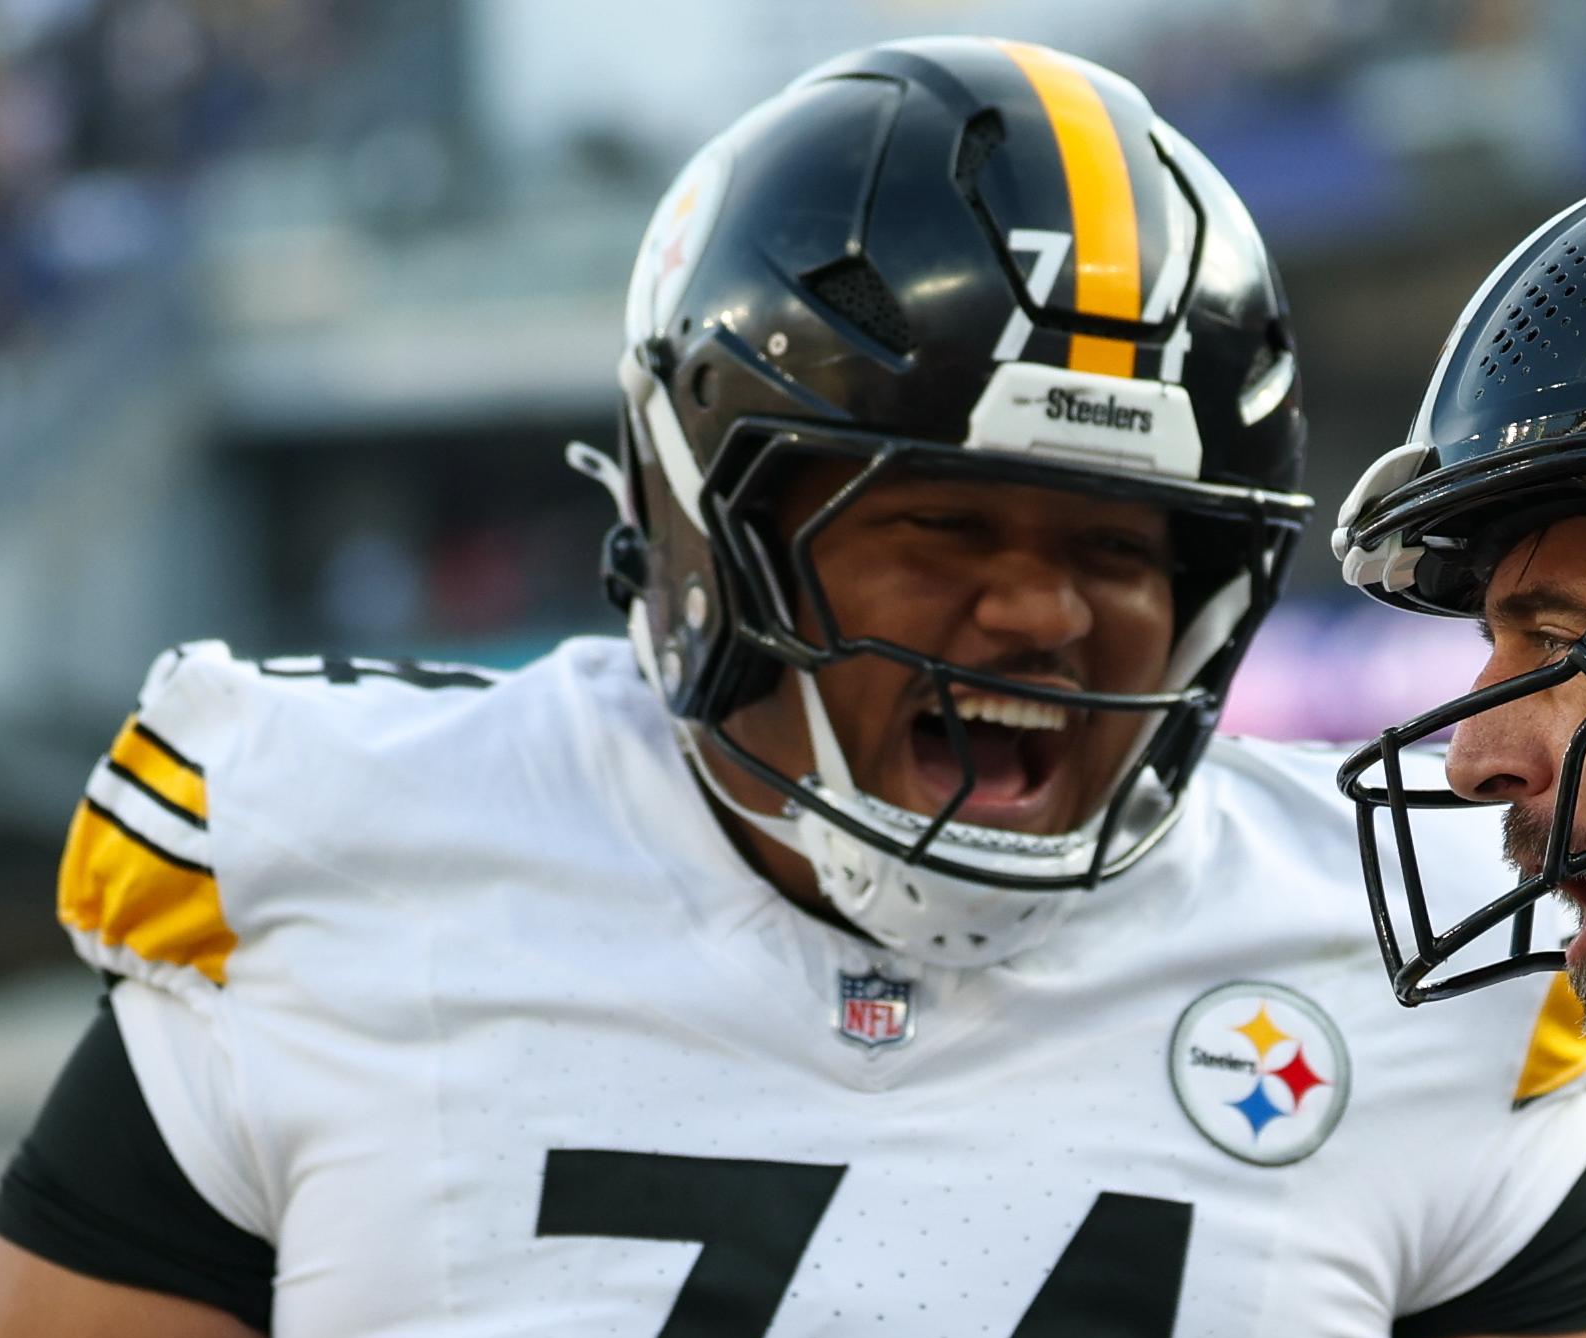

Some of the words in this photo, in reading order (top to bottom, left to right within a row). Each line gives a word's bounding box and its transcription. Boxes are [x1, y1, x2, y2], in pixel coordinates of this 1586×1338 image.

[1046, 387, 1154, 433] Steelers
[846, 1000, 905, 1038] NFL
[1190, 1046, 1257, 1076] Steelers
